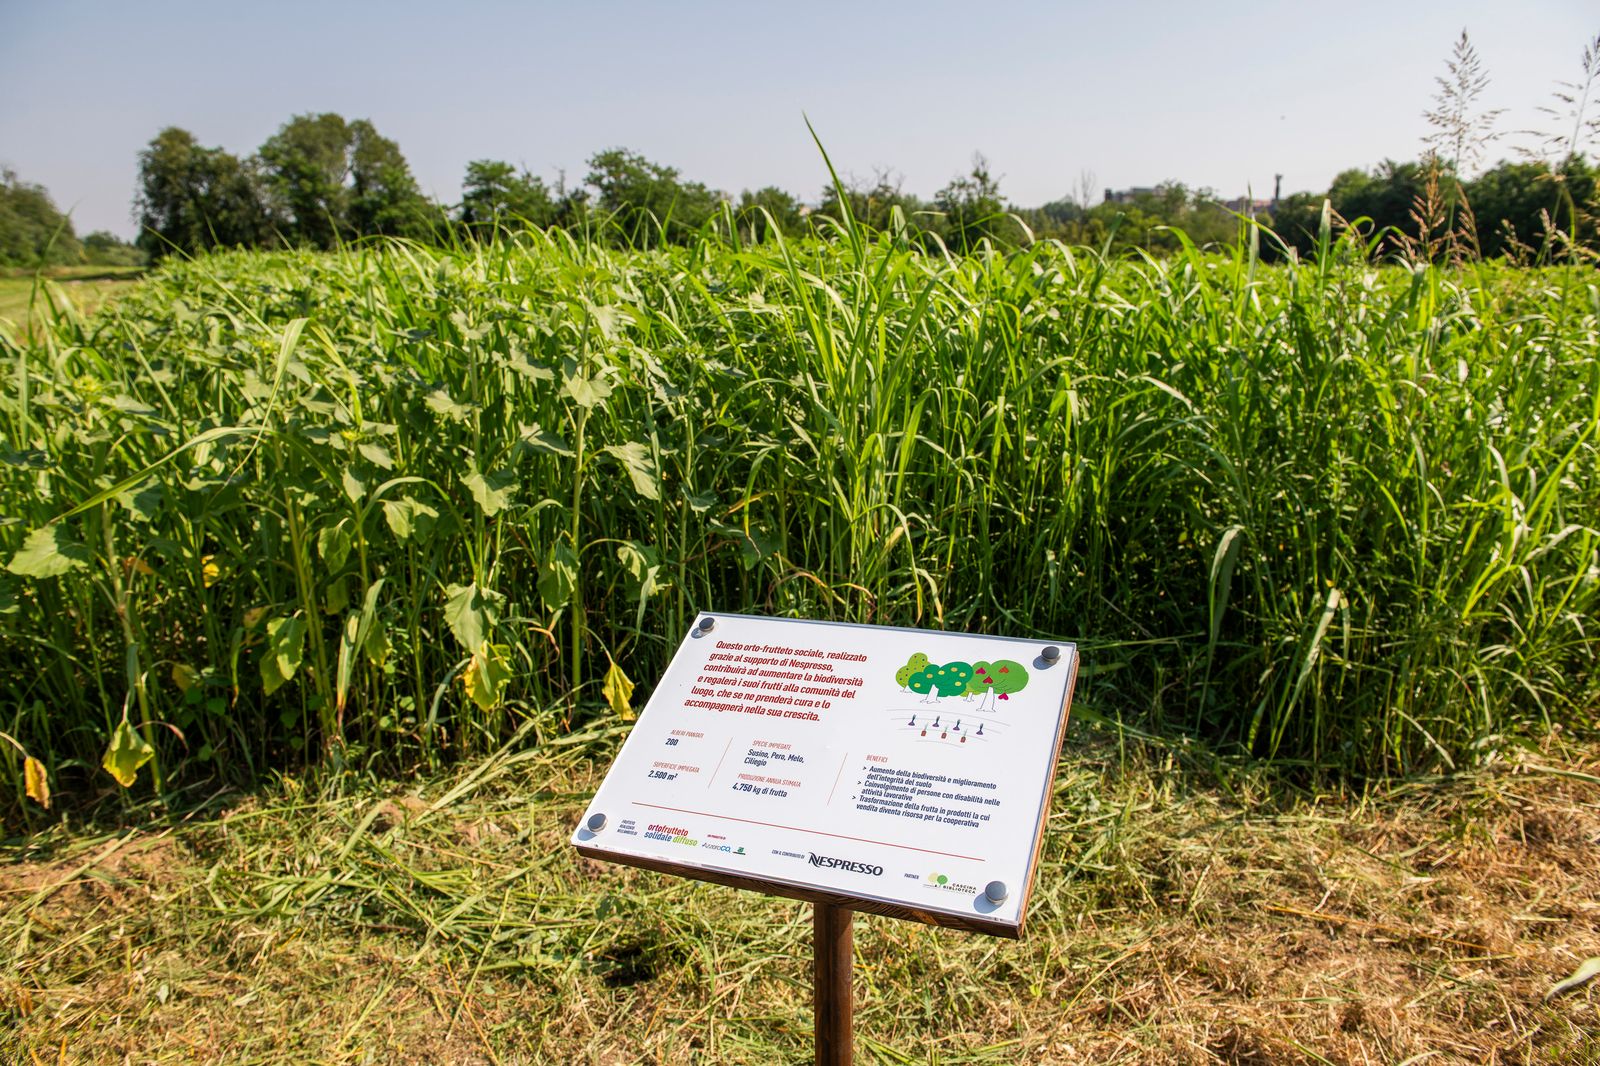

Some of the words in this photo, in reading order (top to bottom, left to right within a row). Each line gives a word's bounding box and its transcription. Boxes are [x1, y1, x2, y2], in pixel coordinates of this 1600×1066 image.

[716, 641, 743, 650] Questo
[744, 645, 793, 655] orto-frutteto
[794, 649, 824, 659] sociale,
[826, 652, 867, 662] realizzato
[709, 653, 734, 661] grazie
[743, 657, 779, 666] supporto
[789, 659, 833, 672] Nespresso,
[704, 665, 747, 674] contribuirà
[758, 670, 803, 680] aumentare
[804, 673, 813, 681] la
[813, 674, 863, 687] biodiversità
[691, 686, 715, 697] luogo,
[717, 689, 732, 698] che
[754, 695, 793, 705] prenderà
[794, 699, 814, 707] cura
[822, 700, 831, 709] lo
[703, 677, 737, 686] regalerà
[738, 678, 743, 686] i
[742, 680, 761, 688] suoi
[760, 681, 783, 691] frutti
[782, 684, 800, 692] alla
[800, 687, 840, 697] comunità
[841, 689, 856, 698] del
[684, 700, 744, 712] accompagnerà
[744, 706, 766, 715] nella
[766, 709, 783, 717] sua
[783, 711, 820, 721] crescita.
[744, 757, 767, 767] Ciliegio
[748, 749, 769, 759] Susino,
[771, 752, 786, 761] Pero,
[788, 754, 804, 763] Melo,
[648, 770, 668, 779] 2.500
[869, 766, 895, 775] Aumento
[896, 770, 911, 779] della
[912, 772, 946, 782] biodiversità
[952, 778, 997, 790] miglioramento
[732, 783, 753, 792] 4.750
[752, 786, 761, 795] kg
[769, 788, 787, 797] frutta
[864, 780, 909, 793] Coinvolgimento
[916, 789, 941, 797] persone
[954, 794, 983, 804] disabilità
[884, 790, 913, 801] lavorative
[857, 804, 878, 812] vendita
[879, 807, 901, 816] diventa
[902, 810, 923, 819] risorsa
[943, 815, 979, 828] cooperativa
[860, 795, 904, 808] Trasformazione
[904, 802, 920, 810] della
[921, 804, 938, 813] frutta
[946, 810, 972, 818] prodotti
[644, 832, 672, 842] solidale
[673, 837, 697, 846] diffuso
[648, 824, 689, 836] ortofrutteto
[808, 852, 884, 876] NESPRESSO
